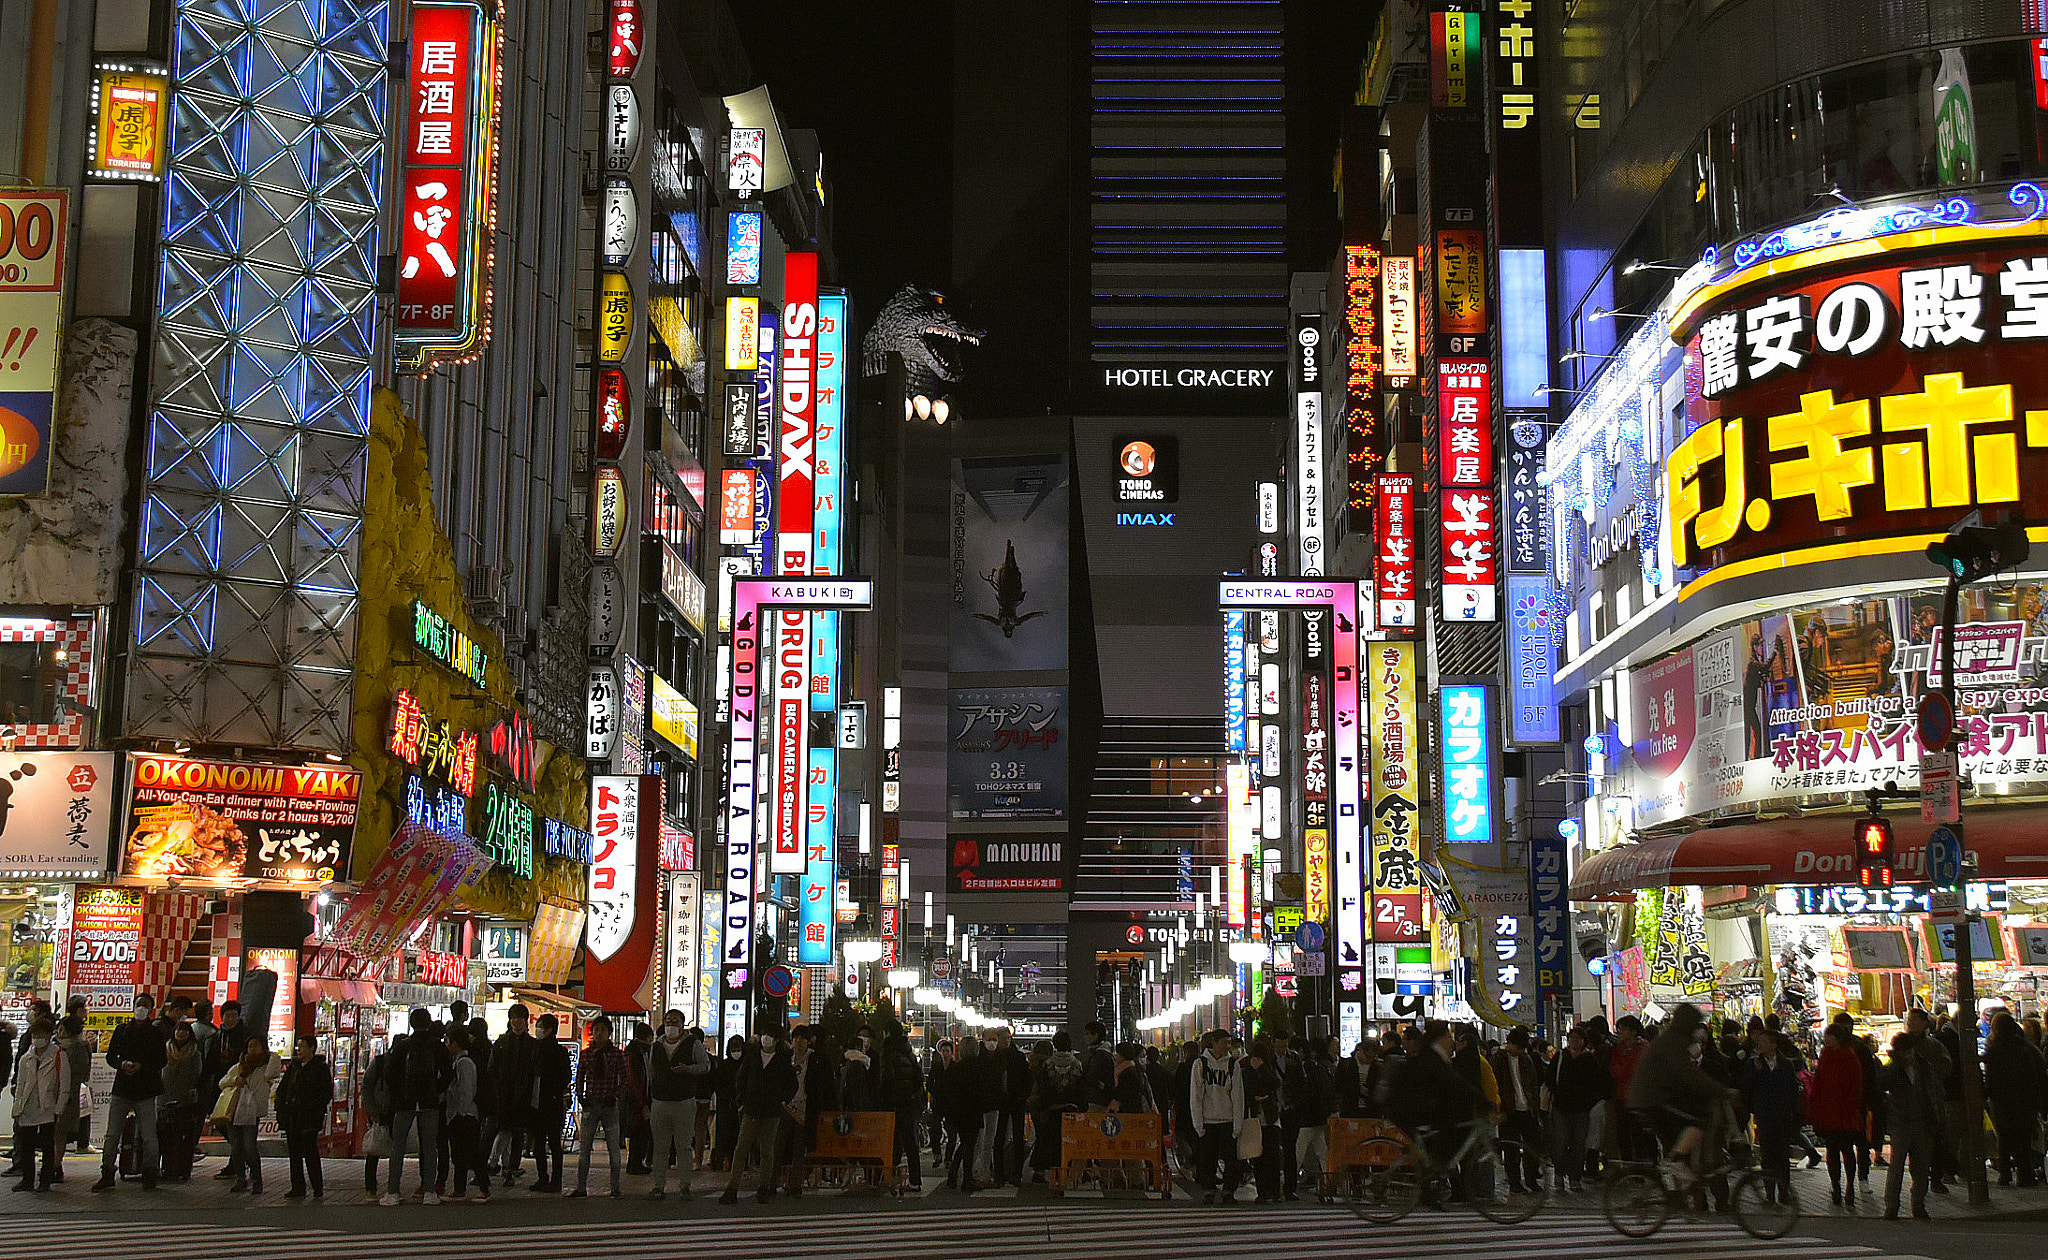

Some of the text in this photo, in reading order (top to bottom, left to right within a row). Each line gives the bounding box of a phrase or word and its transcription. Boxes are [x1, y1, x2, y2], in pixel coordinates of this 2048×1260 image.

[612, 12, 638, 57] つぼ八
[106, 75, 131, 86] 4F
[612, 66, 630, 75] 7F
[416, 40, 457, 155] 居酒屋
[117, 106, 142, 150] 虎の子
[614, 102, 629, 149] ヤキトリ
[608, 157, 630, 168] 6F
[738, 190, 752, 199] 8F
[400, 181, 458, 280] つぼ八
[608, 256, 622, 264] 5F
[605, 297, 629, 341] 虎の子
[602, 350, 619, 358] 4F
[1299, 327, 1319, 382] Booth
[1450, 337, 1476, 353] 6F
[1105, 369, 1274, 387] HOTEL GRACERY
[1391, 376, 1410, 388] 6F
[781, 302, 817, 482] SHIDAX
[729, 387, 750, 446] 山内農場
[1305, 400, 1317, 463] ネットカフェ
[1450, 396, 1481, 483] 居楽屋
[7, 443, 28, 465] 円
[1119, 480, 1152, 490] TOHO
[1306, 469, 1316, 479] &
[1119, 491, 1164, 500] CINEMAS
[1512, 450, 1535, 563] かんかん商店
[601, 482, 617, 548] お好み焼き
[1116, 513, 1175, 526] IMAX
[1390, 497, 1403, 536] 居楽屋
[1306, 541, 1318, 552] 8F
[1443, 493, 1491, 582] 笑笑
[1226, 588, 1334, 598] CENTRAL ROAD
[594, 647, 610, 656] 1F
[1520, 635, 1534, 689] STAGE
[1534, 636, 1547, 680] IDOL
[591, 673, 611, 682] 新宿
[590, 683, 611, 735] かっぱ
[1381, 648, 1405, 763] きんくら酒場
[1523, 706, 1548, 723] 5F
[1648, 688, 1676, 733] 免税
[1770, 703, 1831, 724] Attraction
[1836, 698, 1870, 718] built
[1876, 696, 1896, 711] for
[1901, 698, 1914, 709] a
[1964, 690, 1996, 708] spy
[956, 703, 1059, 740] アサシン
[591, 742, 608, 753] B1
[994, 730, 1058, 752] クリード
[1662, 734, 1678, 754] Free
[990, 762, 1018, 779] 3.3
[1449, 691, 1482, 836] カラオケ
[71, 768, 93, 788] 立
[138, 760, 361, 798] OKONOMI YAKI
[729, 637, 754, 929] GODZILLA ROAD
[782, 704, 797, 848] BIC CAMERA SHIDAX
[1384, 779, 1407, 787] KURA
[1337, 664, 1357, 911] ゴジラロード
[137, 789, 357, 814] All-You-Can-Eat dinner with Free-Flowing
[621, 779, 638, 841] 大衆酒場
[1307, 801, 1325, 814] 4F
[66, 796, 94, 850] 蕎麦
[224, 808, 354, 826] Drinks for 2 hours ¥2,700
[1307, 814, 1325, 826] 3F
[594, 786, 620, 890] トラノコ
[1374, 793, 1419, 890] 金の蔵
[5, 854, 99, 866] SOBA Eat standing
[806, 766, 828, 943] カラオケ館
[986, 843, 1061, 862] MARUHAN
[1795, 851, 1852, 873] Don
[319, 869, 332, 879] 2F
[77, 889, 142, 905] お好み焼き
[1308, 854, 1324, 922] やきとり
[1377, 900, 1406, 923] 2F
[1536, 848, 1564, 964] カラオケ
[74, 941, 137, 963] 2,700円
[248, 949, 297, 960] OKONOMI
[1496, 915, 1522, 1011] カラオケ
[487, 967, 524, 978] 虎の子
[1540, 971, 1564, 987] B1
